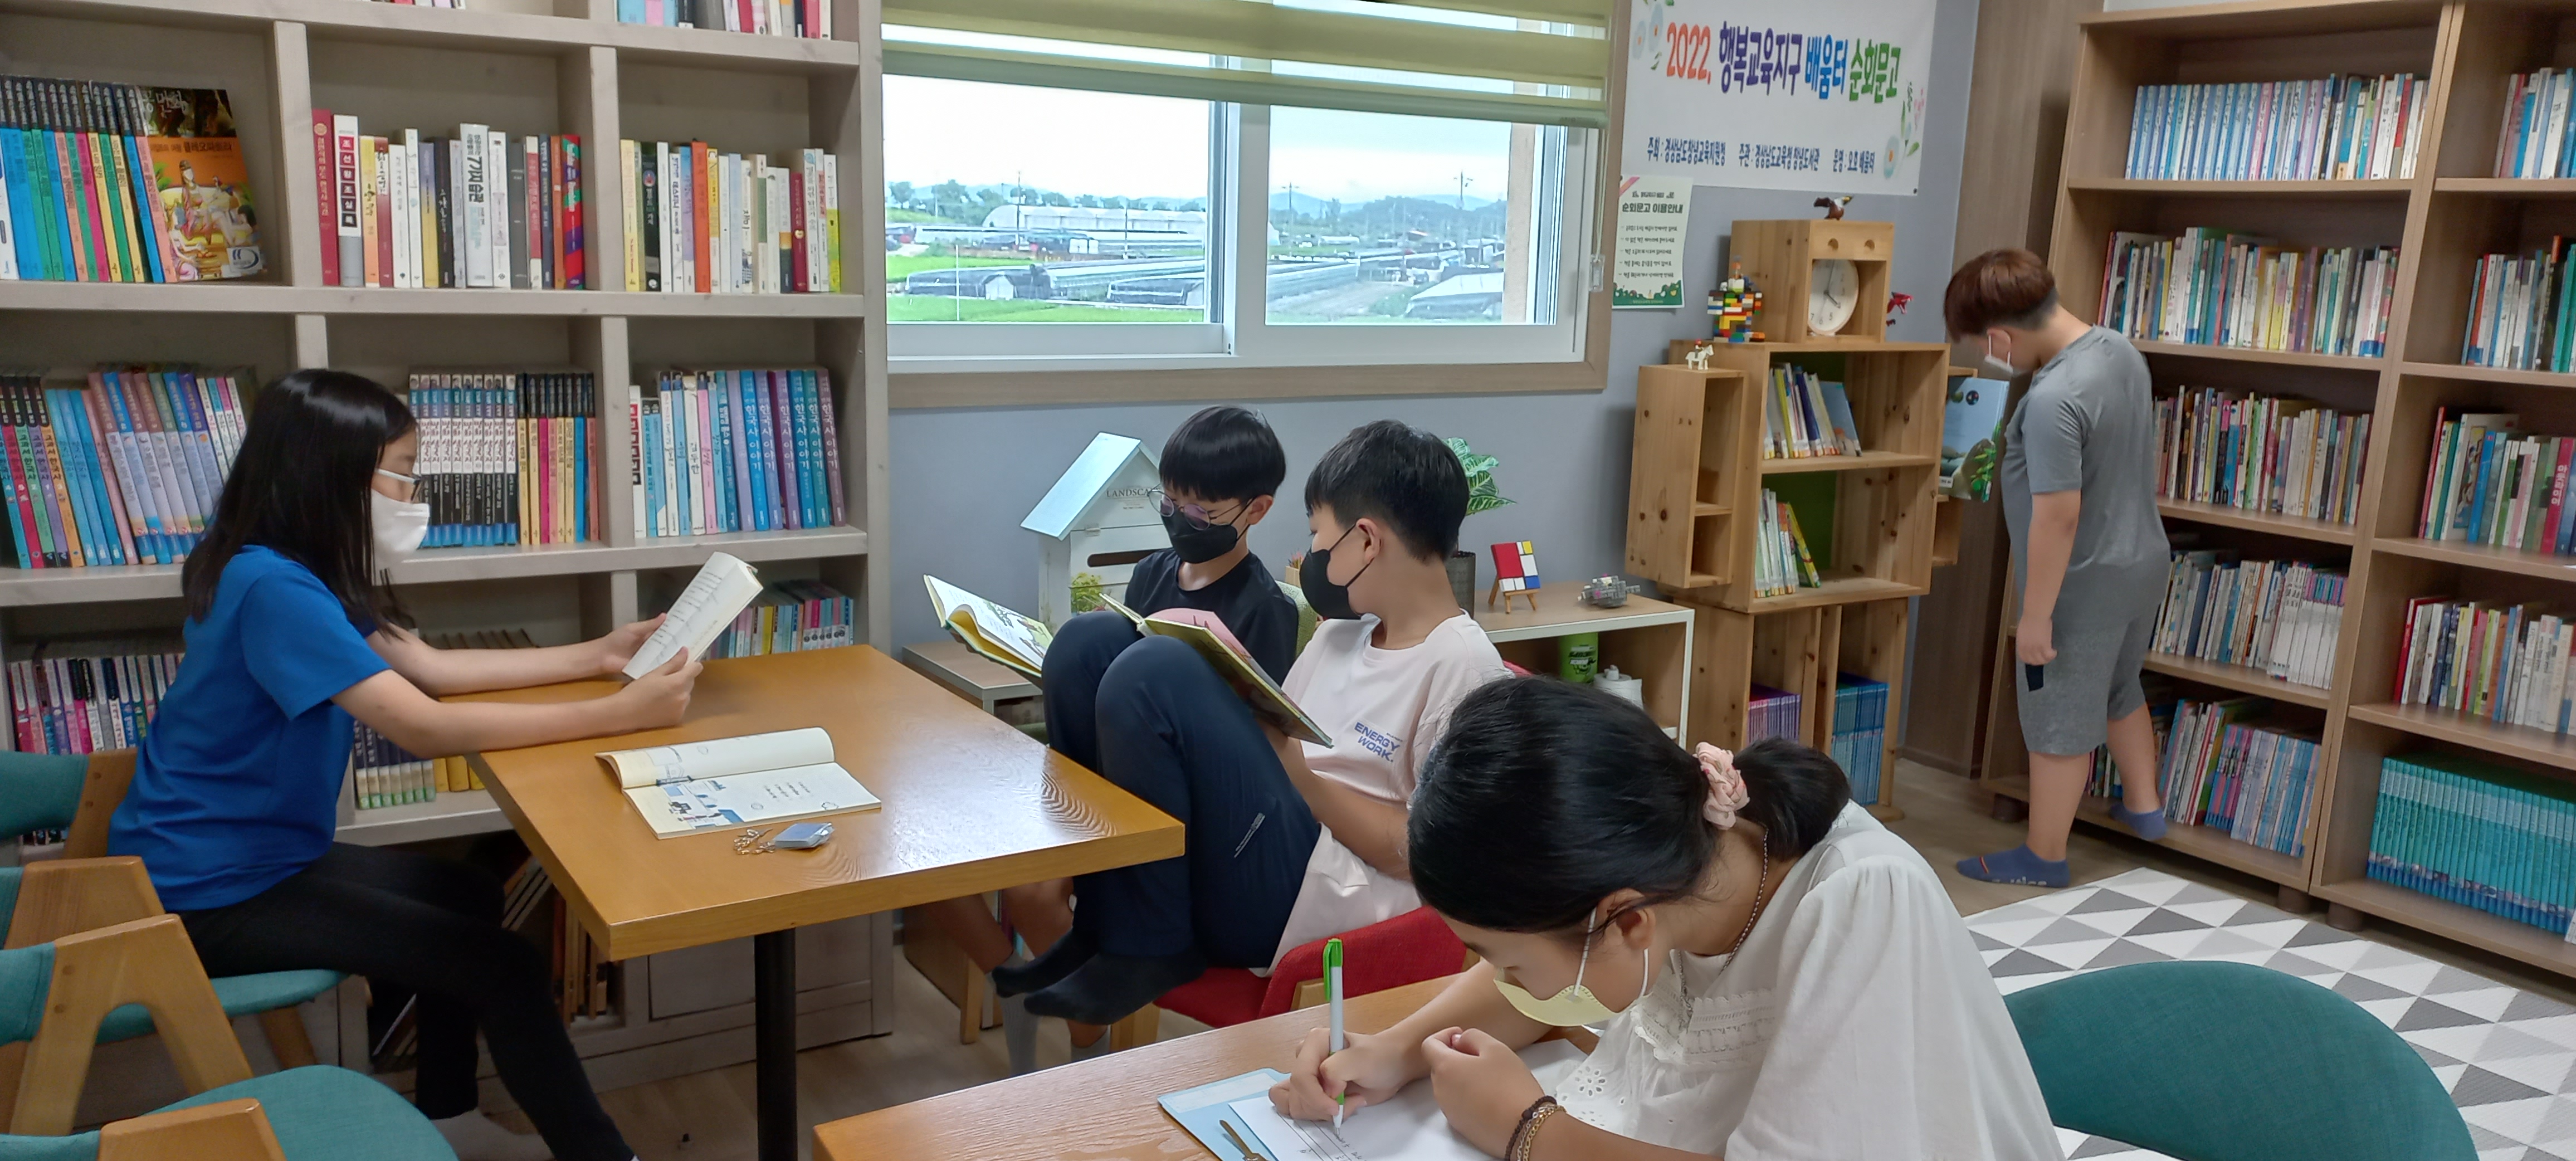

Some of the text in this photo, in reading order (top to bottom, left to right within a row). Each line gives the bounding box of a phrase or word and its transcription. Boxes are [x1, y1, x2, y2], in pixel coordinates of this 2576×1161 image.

[1719, 20, 1803, 96] 행복교육지구
[1804, 33, 1849, 100] 배움터
[1848, 37, 1901, 104] 순회문고
[1647, 137, 1660, 162] 주최
[1739, 143, 1751, 168] 주관
[1833, 149, 1845, 173] 운영
[468, 183, 485, 203] 습관
[1622, 202, 1684, 214] 순회문고 이용안내
[1811, 313, 1814, 321] 7
[1829, 311, 1833, 321] 5
[794, 403, 807, 436] 한국사
[19, 435, 31, 455] 교과서
[32, 435, 44, 455] 교과서
[45, 435, 56, 455] 교과서
[744, 404, 762, 472] 한국사 이야기
[759, 403, 776, 472] 한국사 이야기
[780, 404, 795, 472] 한국사 이야기
[808, 403, 824, 470] 한국사 이야기
[821, 403, 839, 470] 한국사 이야기
[797, 438, 811, 470] 이야기
[24, 457, 37, 481] 한국사
[37, 458, 50, 480] 한국사
[49, 457, 61, 480] 한국사
[1354, 721, 1401, 752] ENERGY
[1357, 735, 1394, 763] WORK.
